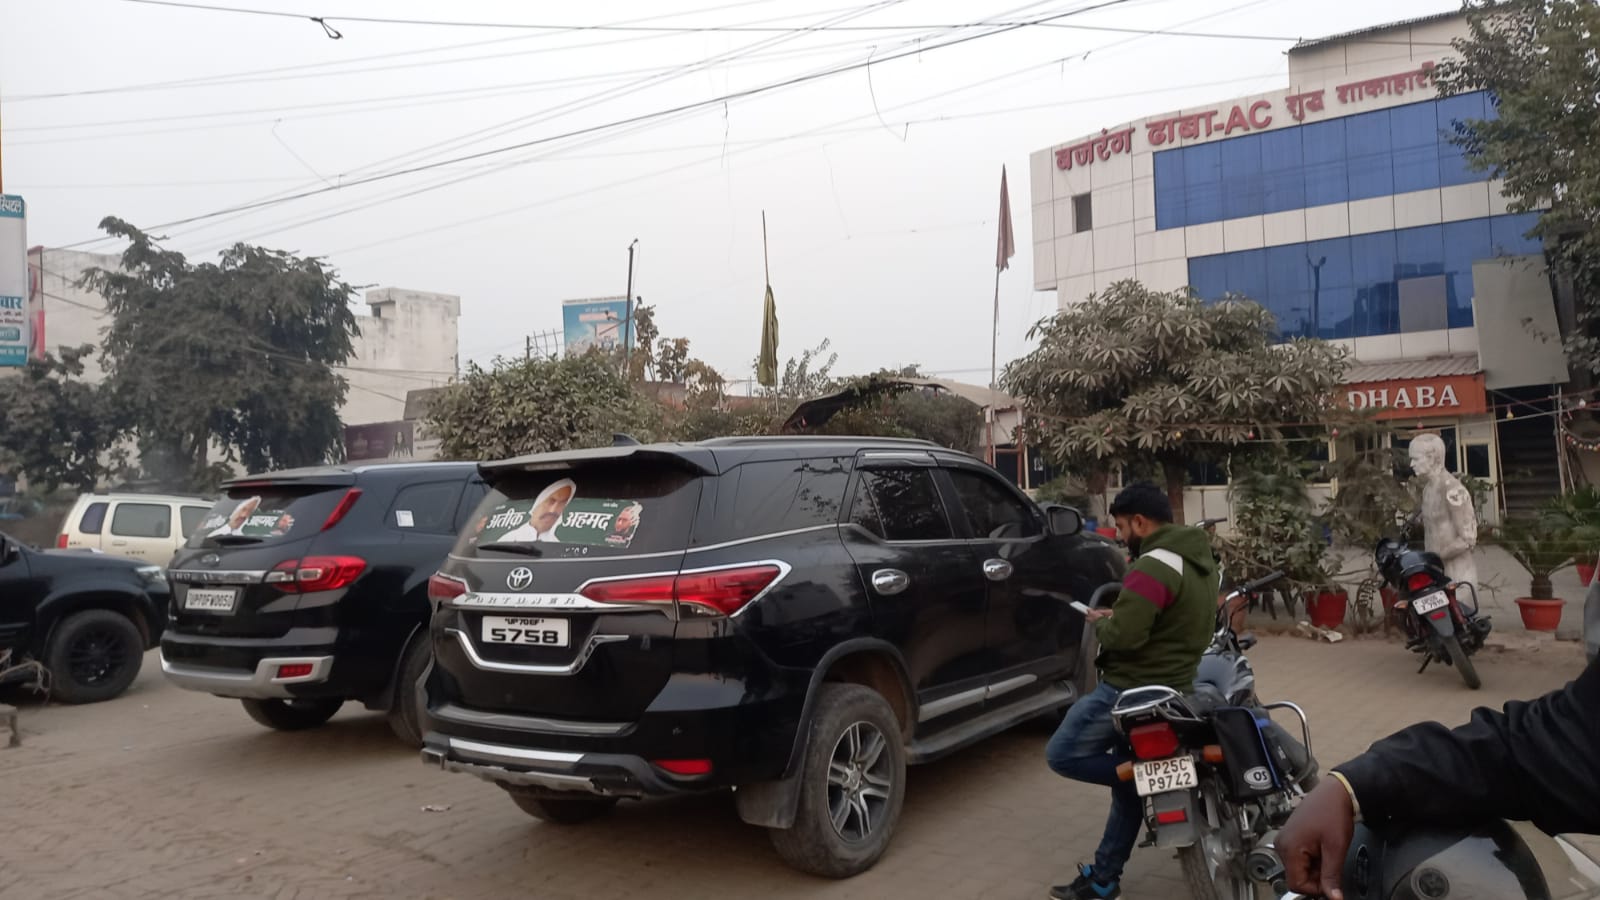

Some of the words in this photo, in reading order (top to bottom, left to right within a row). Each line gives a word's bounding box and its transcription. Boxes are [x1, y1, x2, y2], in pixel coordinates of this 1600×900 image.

[1055, 128, 1135, 171] बजरंग
[1348, 384, 1460, 411] DHABA
[562, 511, 614, 531] अहमद
[491, 628, 559, 644] 5758
[1144, 758, 1187, 776] UP25C
[1148, 772, 1192, 791] P9742
